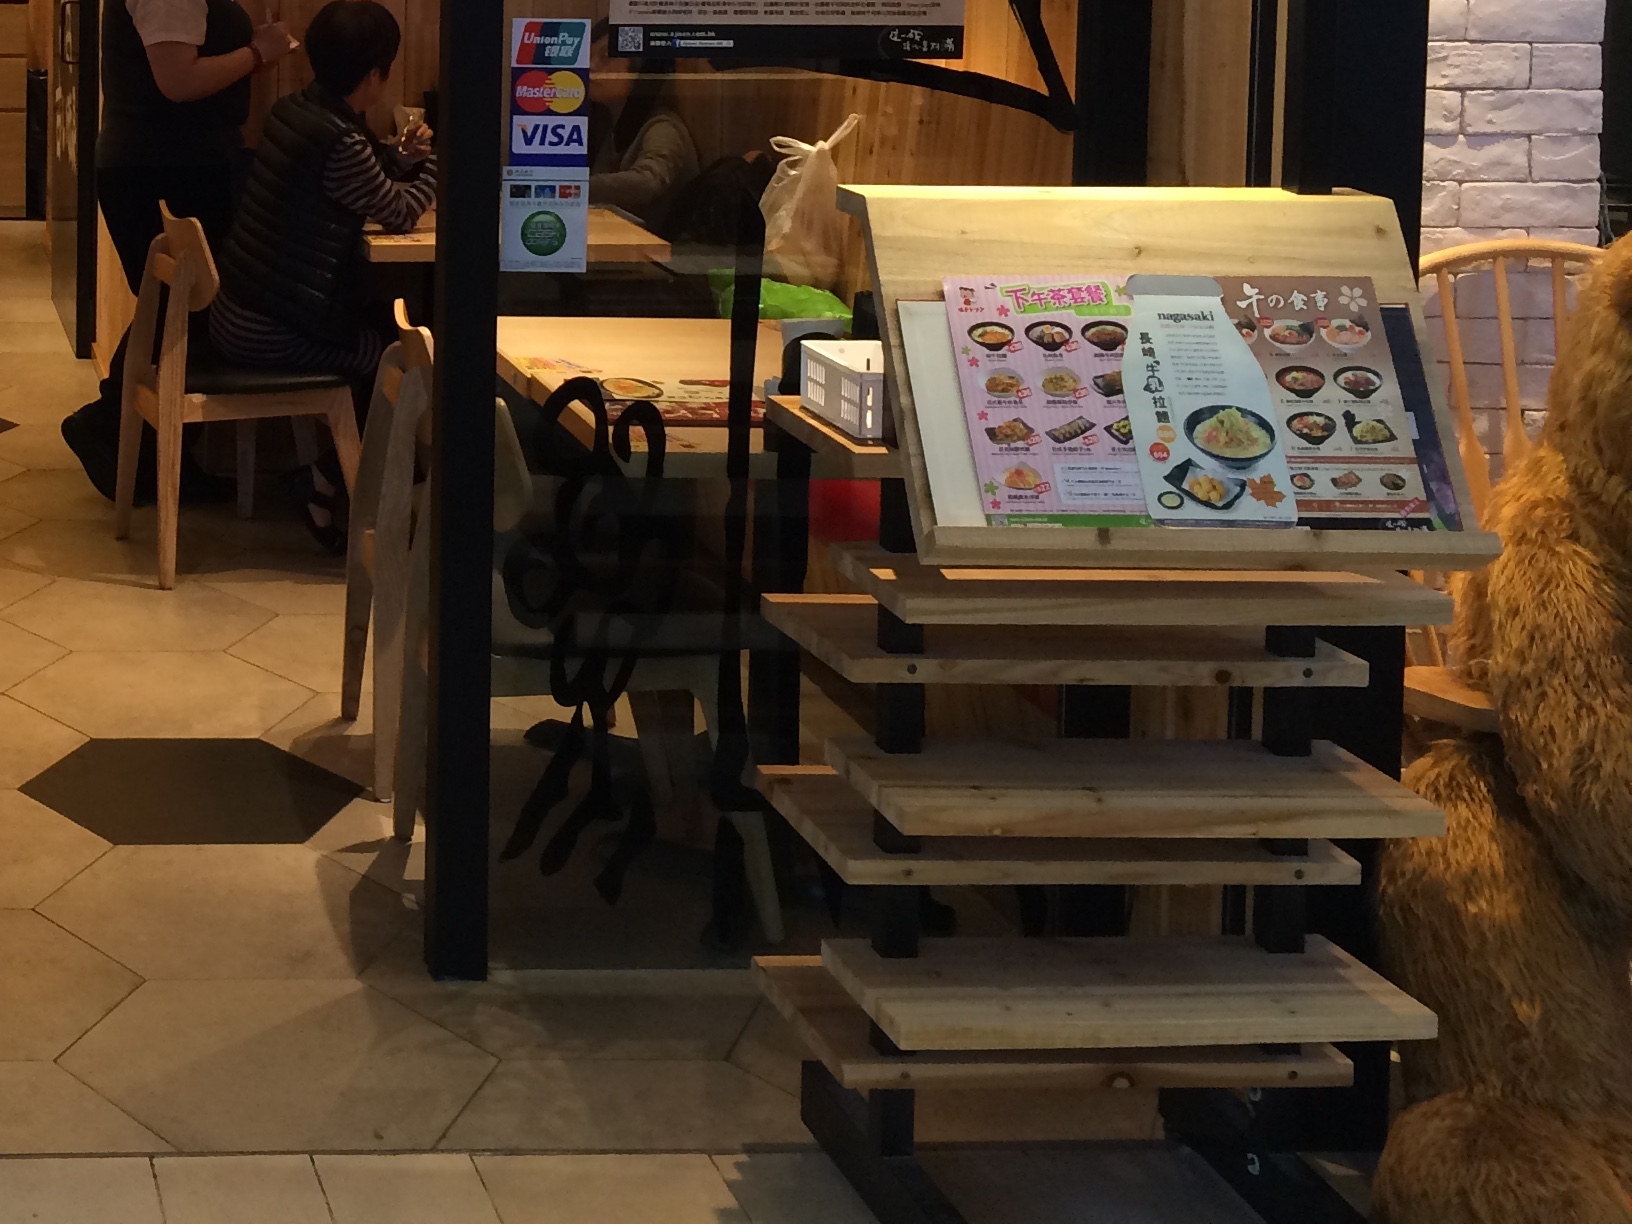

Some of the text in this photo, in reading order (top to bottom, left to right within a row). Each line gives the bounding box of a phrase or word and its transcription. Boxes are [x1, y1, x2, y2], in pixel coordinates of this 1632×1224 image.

[523, 32, 582, 48] UnionPay
[515, 85, 582, 99] MasterCard
[519, 124, 584, 147] VISA
[1004, 284, 1108, 311] 下午茶套餐
[1157, 311, 1215, 324] nagasaki
